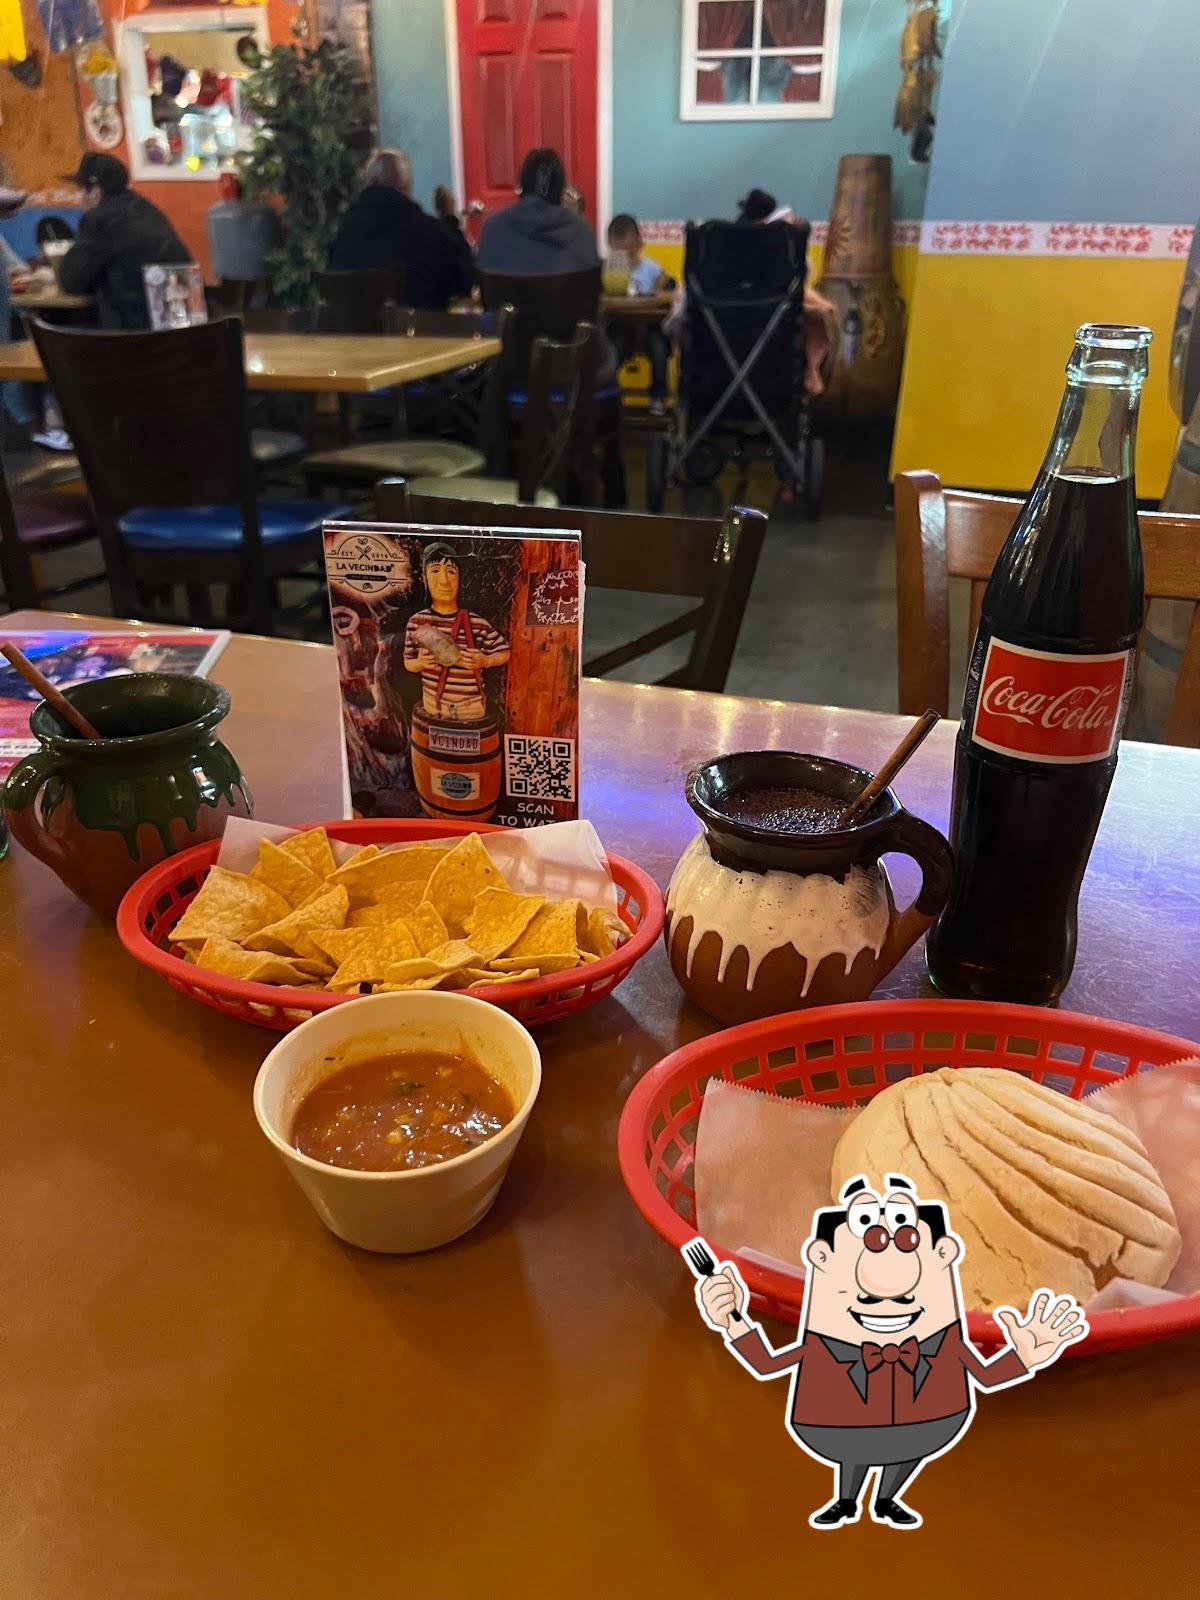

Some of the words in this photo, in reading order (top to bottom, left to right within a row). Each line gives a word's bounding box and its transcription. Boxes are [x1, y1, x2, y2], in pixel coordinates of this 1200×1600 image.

[336, 562, 347, 570] LA
[349, 563, 392, 573] VECINDAD
[517, 802, 555, 816] SCAN
[498, 814, 518, 826] TO
